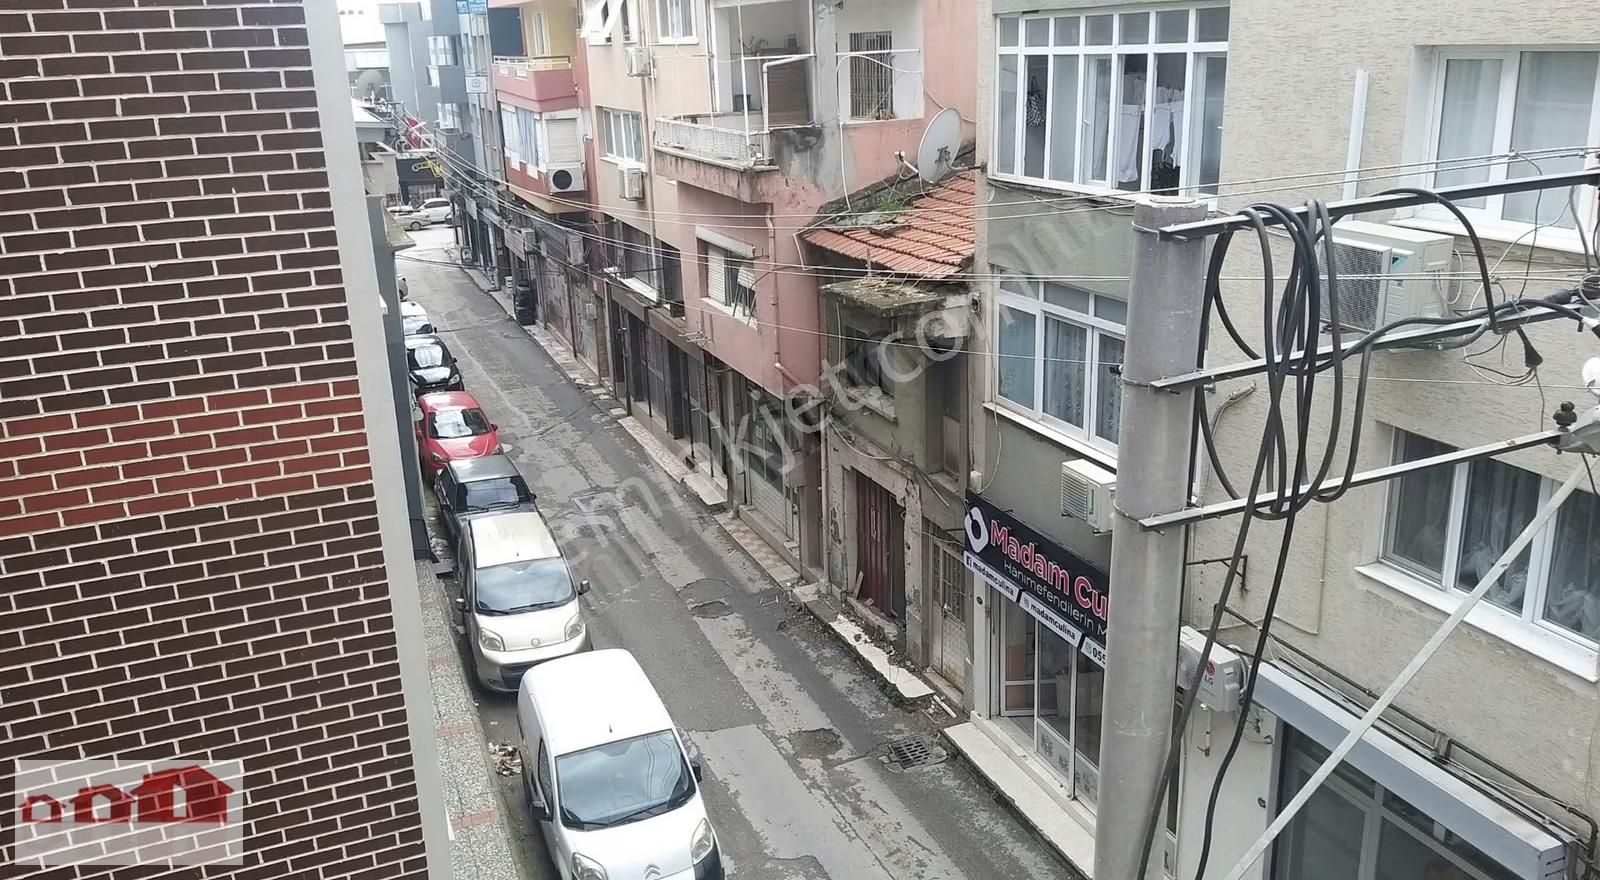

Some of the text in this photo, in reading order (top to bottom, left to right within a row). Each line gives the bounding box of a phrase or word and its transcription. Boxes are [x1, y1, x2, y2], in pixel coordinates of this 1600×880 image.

[990, 519, 1107, 621] Madam Cu
[1030, 603, 1076, 640] madamculina
[1097, 623, 1107, 635] M
[1092, 647, 1106, 665] 055
[1204, 674, 1214, 686] LG
